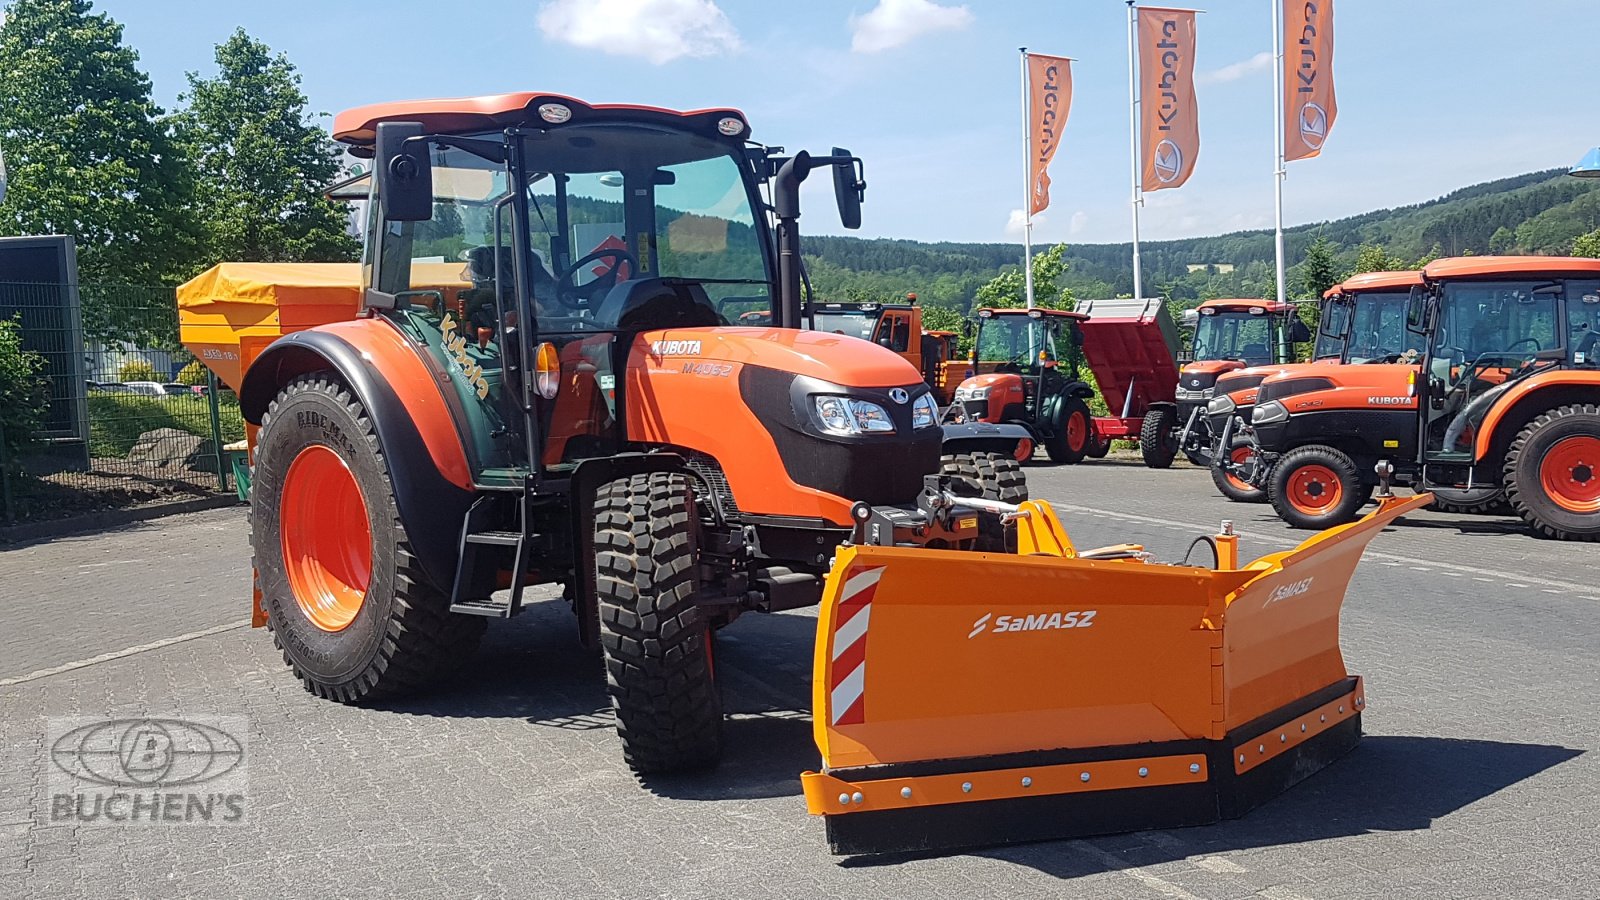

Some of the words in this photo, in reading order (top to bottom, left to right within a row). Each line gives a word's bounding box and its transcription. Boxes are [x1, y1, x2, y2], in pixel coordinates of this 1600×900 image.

[1157, 20, 1178, 131] Kubota
[1039, 65, 1058, 162] Kubota
[440, 312, 489, 400] Kubota
[651, 340, 702, 355] KUBOTA
[1367, 396, 1412, 405] KUBOTA
[992, 610, 1097, 633] SaMASZ
